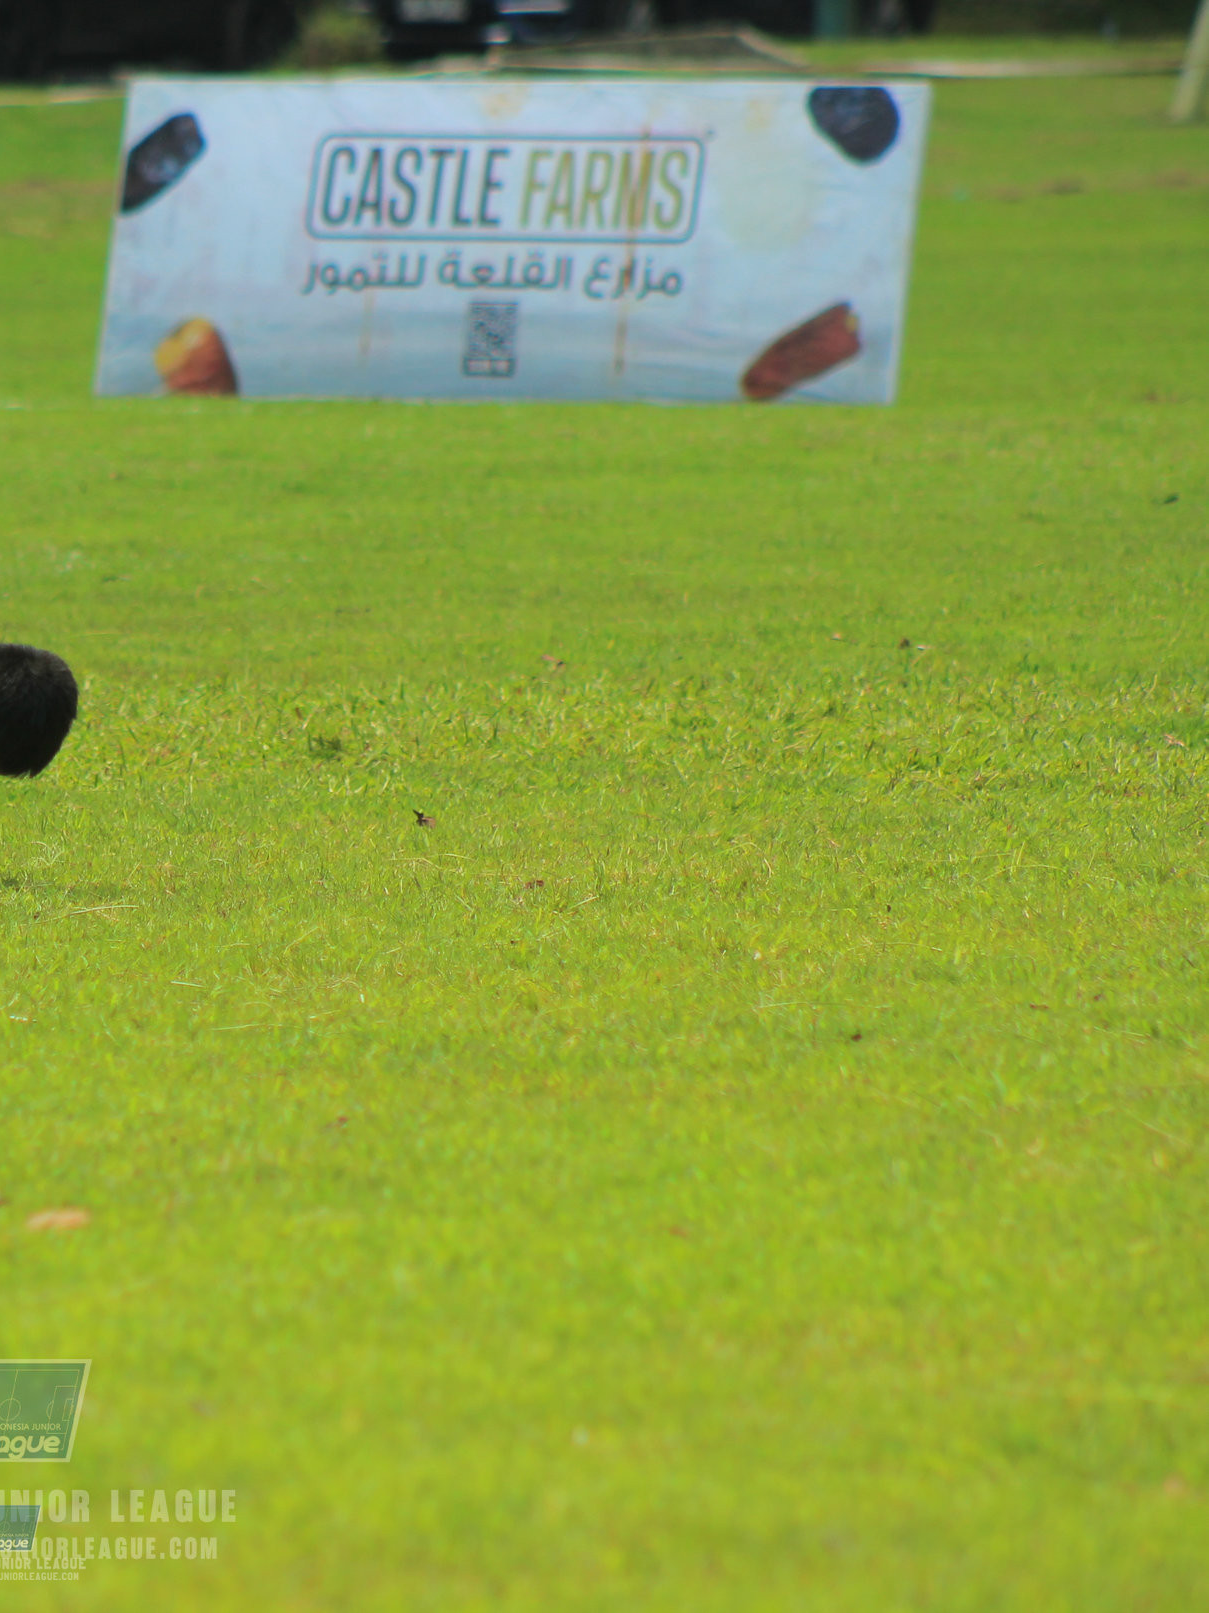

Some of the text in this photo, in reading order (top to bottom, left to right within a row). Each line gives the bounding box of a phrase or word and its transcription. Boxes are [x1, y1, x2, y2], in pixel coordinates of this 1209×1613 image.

[320, 145, 690, 231] CASTLE FARMS
[300, 249, 684, 300] مزارع القلعة للتمور
